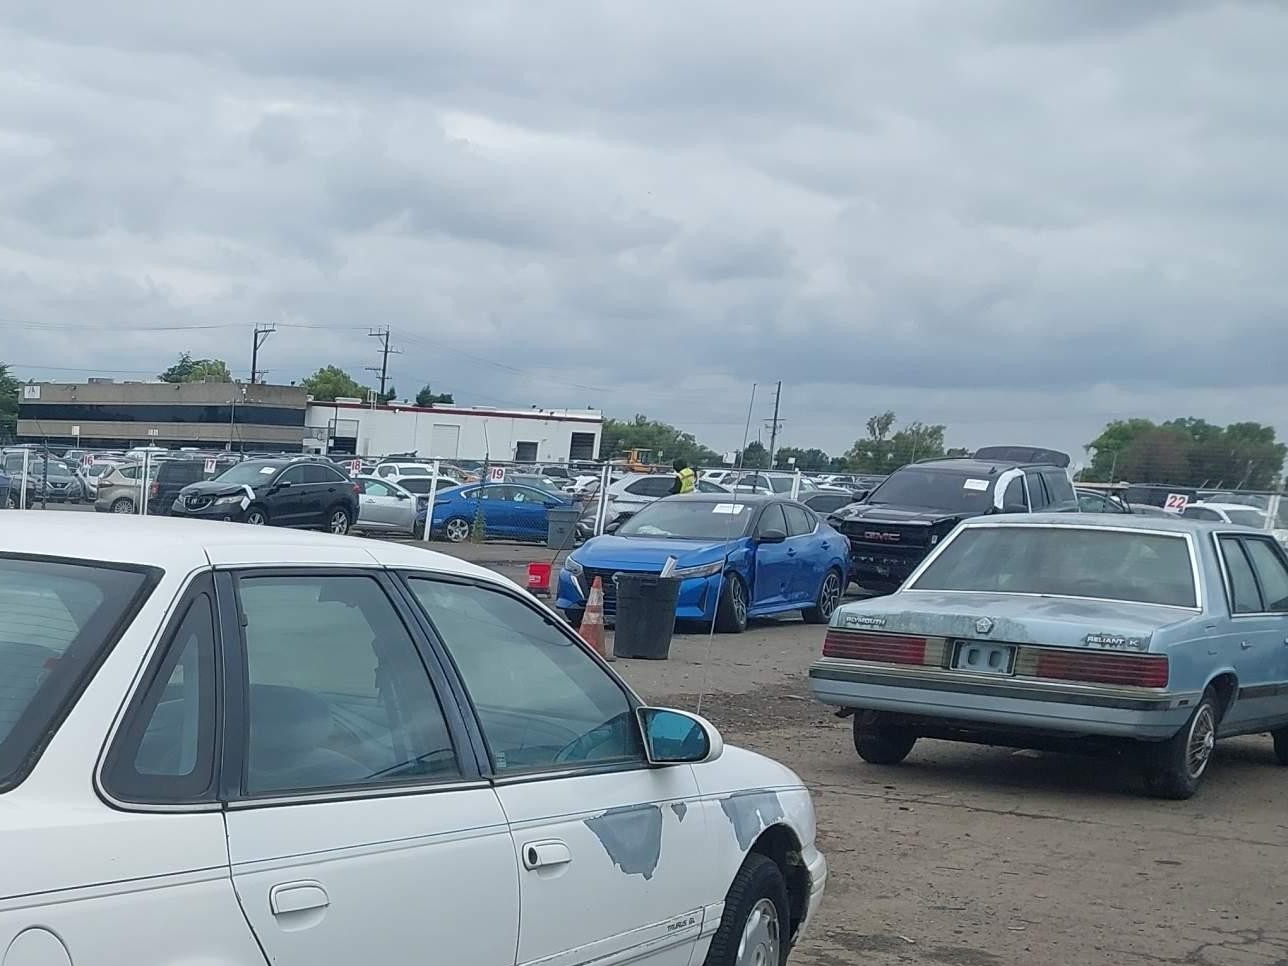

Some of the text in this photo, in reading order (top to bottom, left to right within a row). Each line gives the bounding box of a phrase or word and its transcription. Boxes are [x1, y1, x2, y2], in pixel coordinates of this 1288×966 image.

[84, 456, 93, 466] 16
[206, 460, 215, 470] 17
[352, 460, 360, 471] 18
[492, 469, 504, 480] 19
[1167, 495, 1186, 509] 22
[865, 531, 900, 541] GMC
[846, 616, 886, 625] PLYMOUTH
[1087, 636, 1125, 645] RELIANT
